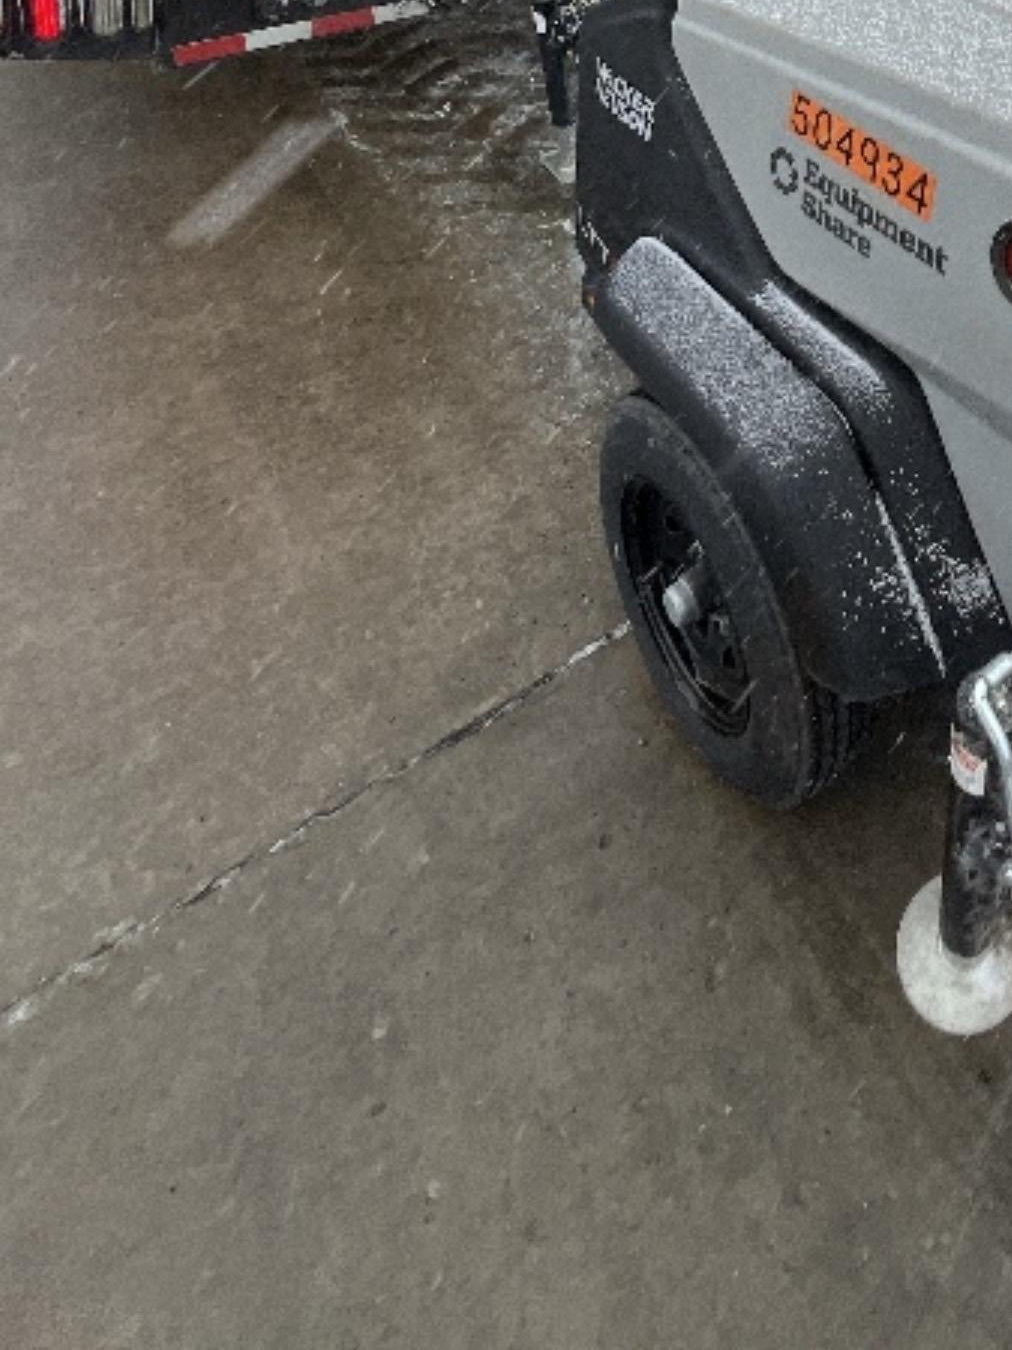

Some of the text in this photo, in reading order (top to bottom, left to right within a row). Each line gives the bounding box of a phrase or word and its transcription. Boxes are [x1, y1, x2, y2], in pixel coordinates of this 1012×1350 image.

[791, 94, 931, 216] 504934
[800, 190, 872, 259] Share
[802, 157, 950, 277] Equipment
